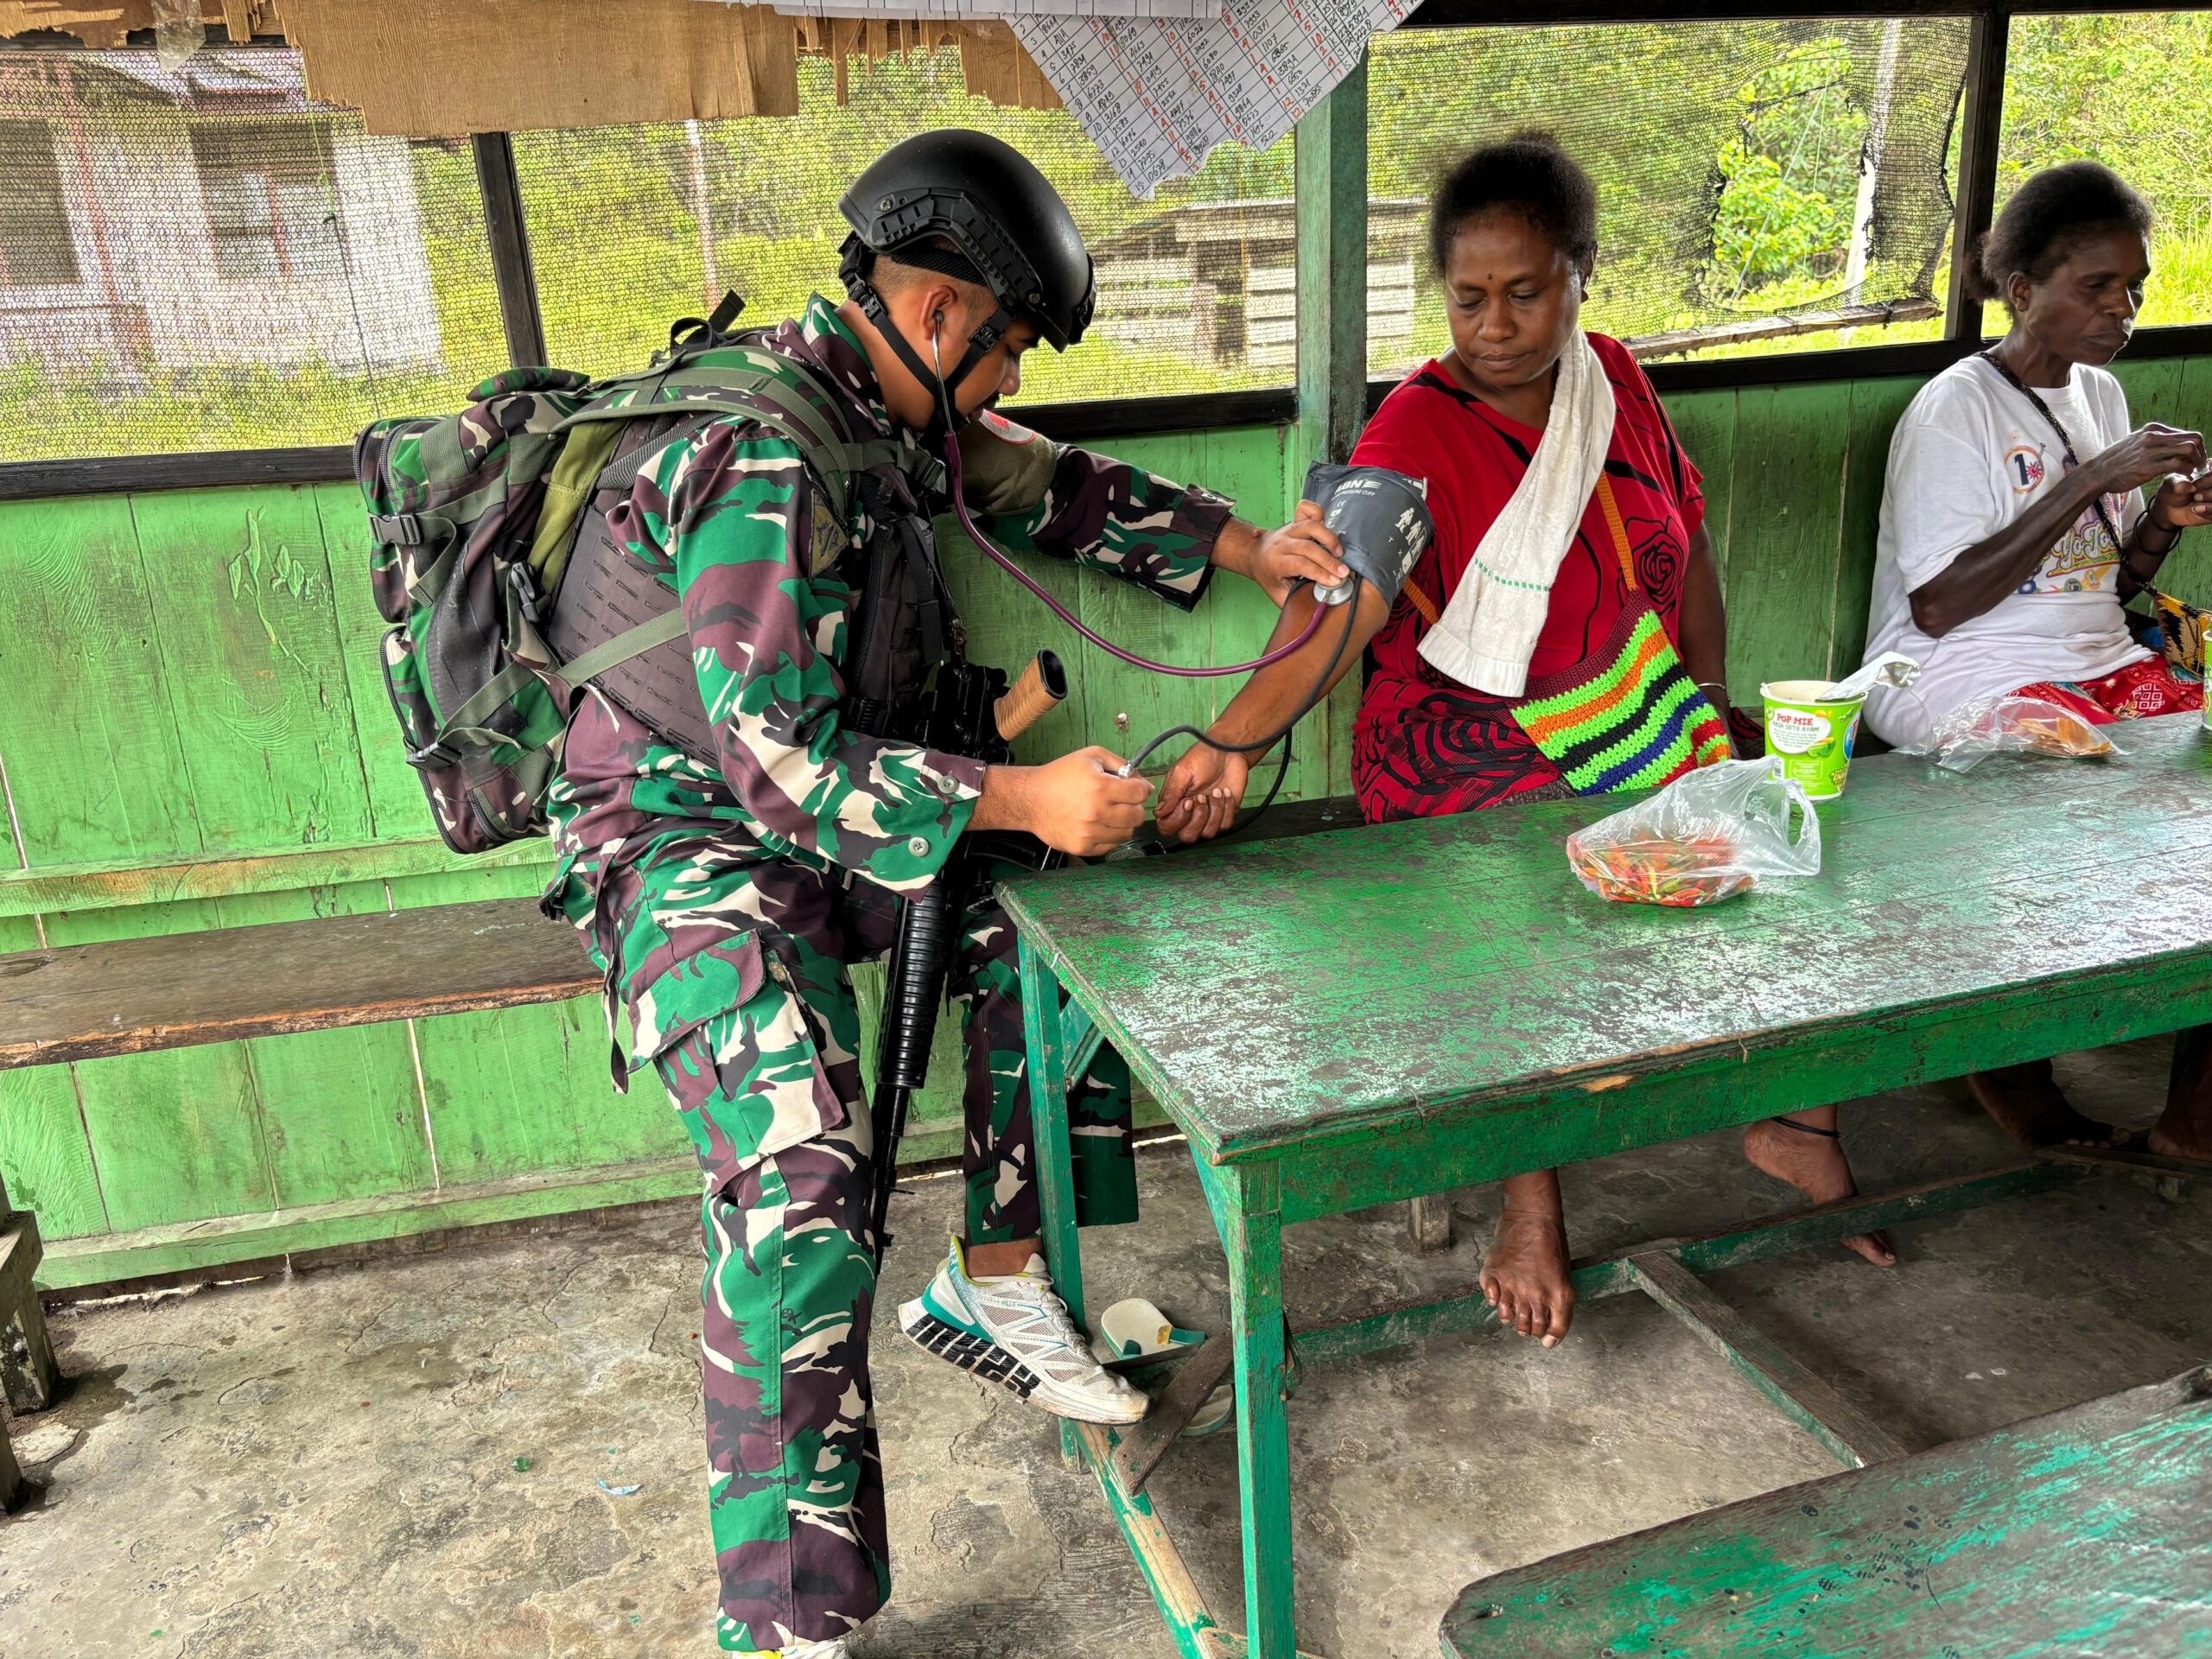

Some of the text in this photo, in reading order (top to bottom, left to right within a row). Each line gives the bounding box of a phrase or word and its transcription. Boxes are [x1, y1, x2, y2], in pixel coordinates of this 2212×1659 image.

[1020, 24, 1026, 35] 2
[1031, 37, 1038, 46] 3
[1166, 31, 1176, 43] 10
[1311, 32, 1323, 48] 10
[1319, 46, 1327, 56] 2
[1050, 61, 1056, 72] 5
[1058, 73, 1065, 85] 6
[1093, 122, 1103, 136] 10
[1104, 102, 1122, 124] 3168
[1187, 23, 1204, 43] 6026
[1199, 79, 1206, 91] 5
[1088, 79, 1104, 99] 6773
[1111, 147, 1120, 158] 12
[1192, 69, 1198, 79] 2
[1203, 50, 1218, 69] 6080
[1168, 130, 1175, 143] 11
[1249, 53, 1258, 66] 1
[1281, 96, 1295, 111] 12
[1135, 181, 1145, 192] 15
[1148, 158, 1166, 182] 0678
[1216, 104, 1224, 114] 2
[1304, 20, 1312, 32] 5
[1291, 107, 1305, 120] 12
[1102, 135, 1109, 147] 11
[1143, 96, 1150, 107] 11
[2014, 454, 2029, 486] 1
[1777, 713, 1813, 726] POP MIE
